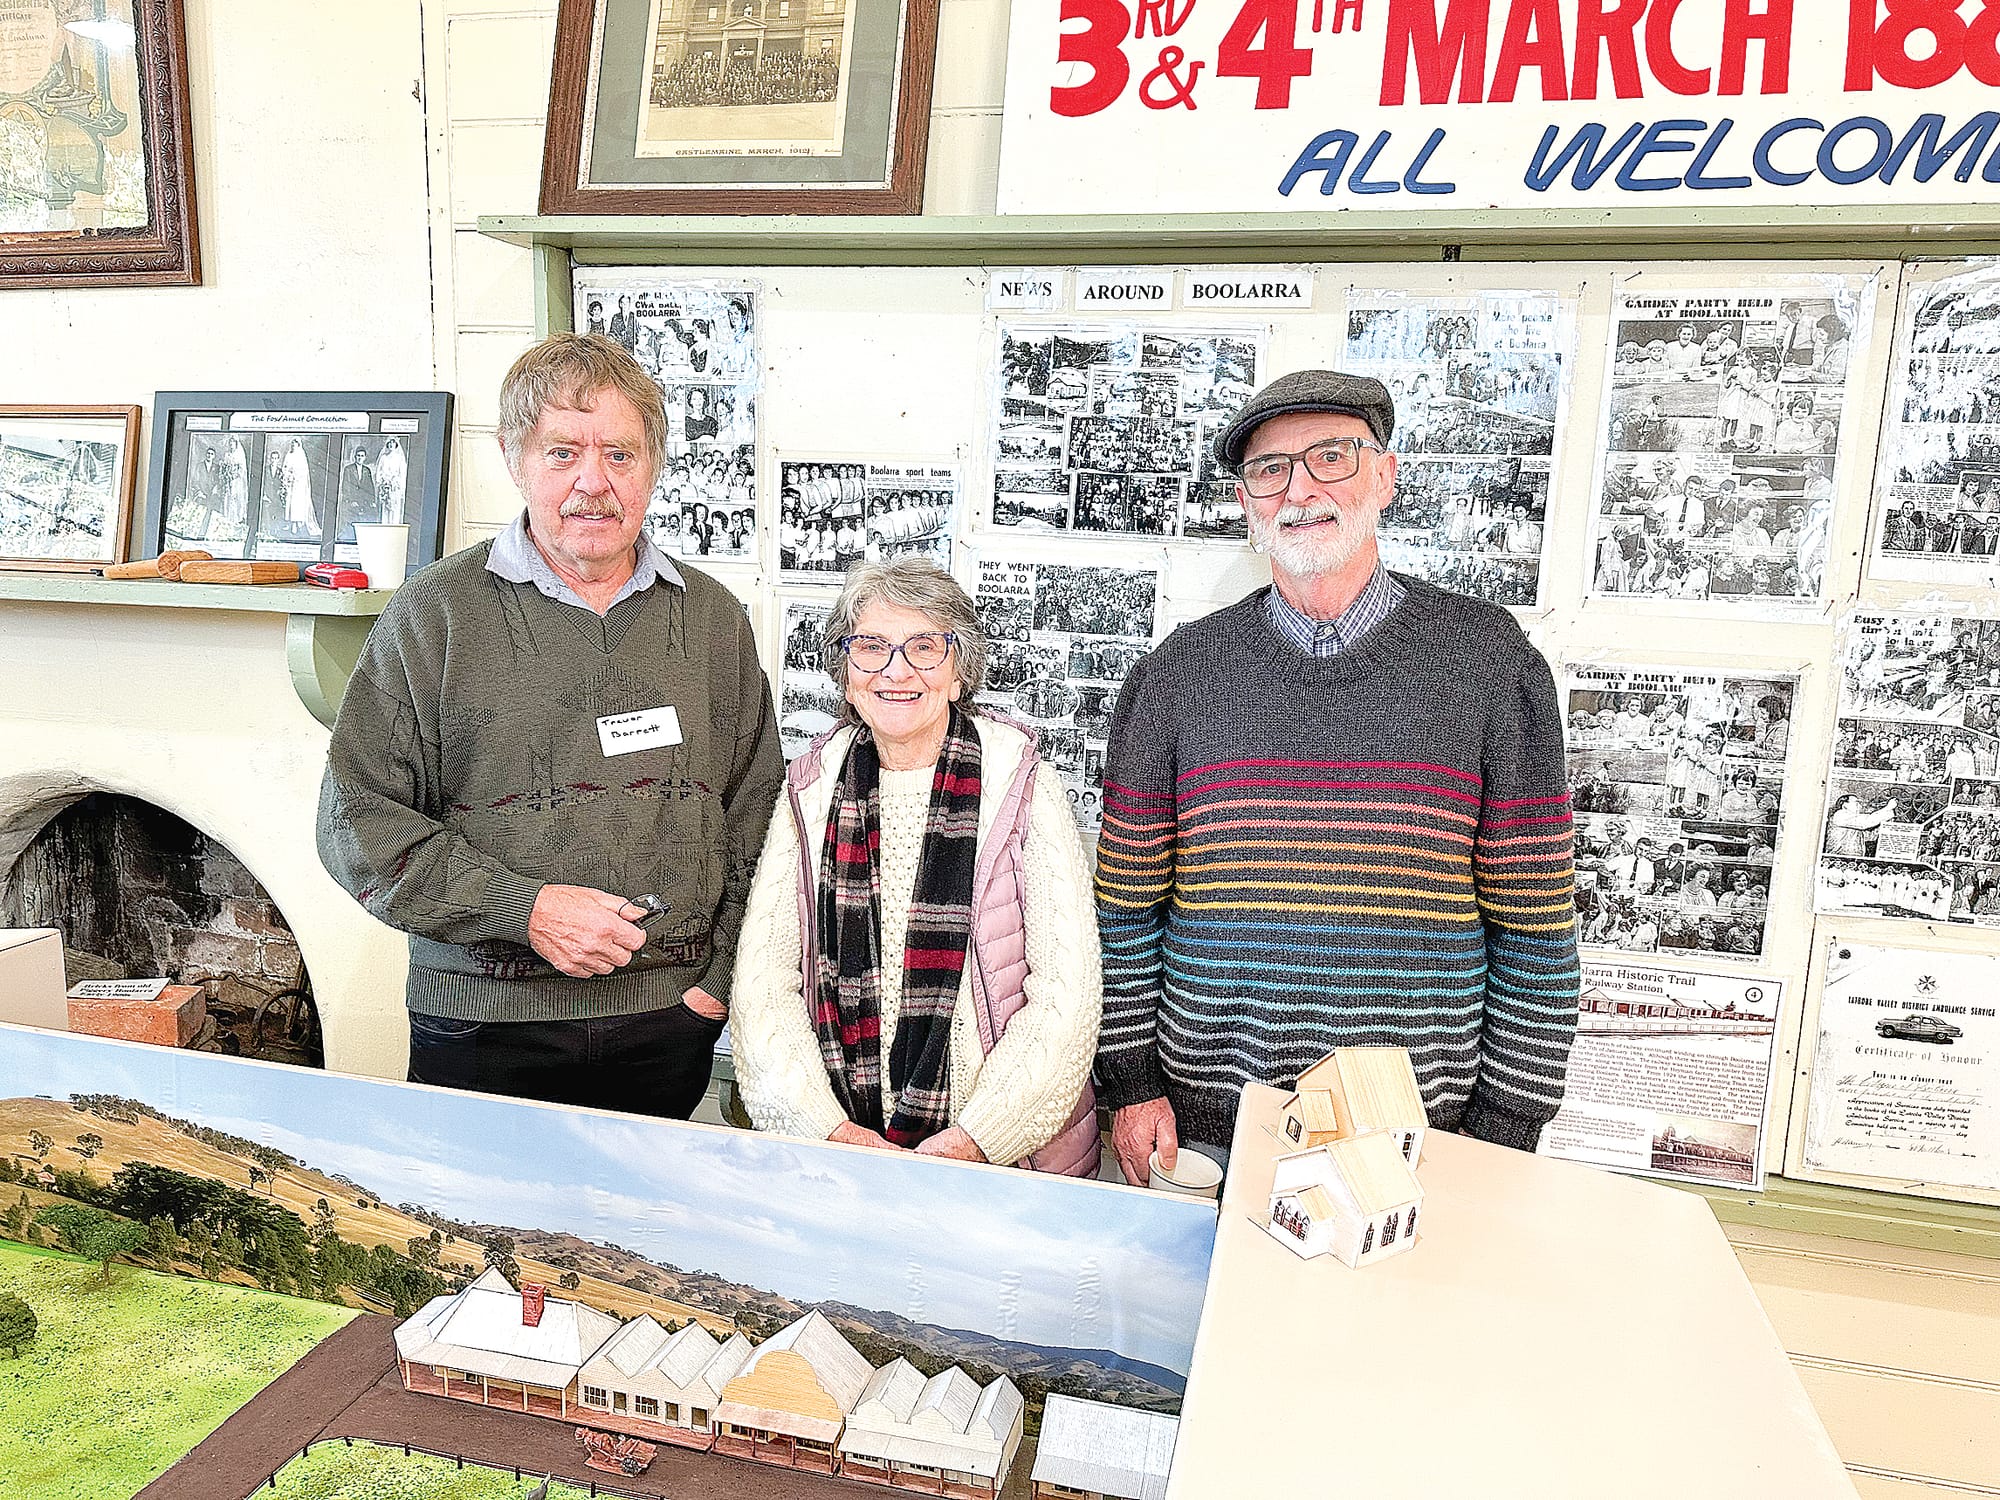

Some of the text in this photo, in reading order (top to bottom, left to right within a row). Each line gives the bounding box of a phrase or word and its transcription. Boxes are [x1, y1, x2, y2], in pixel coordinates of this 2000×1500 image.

[1139, 45, 1206, 111] &
[1379, 0, 1793, 106] MARCH
[1278, 111, 2000, 196] ALL WELCOM
[1000, 282, 1301, 300] NEWS AROUND BOOLARRA
[1625, 299, 1773, 308] GARDEN PARTY HELD
[1655, 309, 1750, 318] AT BOOLARRA
[870, 465, 951, 477] Boolarra sport teams
[979, 561, 1035, 572] THEY WENT
[983, 573, 1027, 583] BACK TO
[978, 584, 1030, 595] BOOLARRA
[1854, 615, 1885, 625] Busy
[1576, 671, 1626, 680] GARDEN
[1633, 673, 1676, 683] PARTY
[1605, 682, 1622, 690] AT
[601, 716, 643, 726] Trevor
[611, 724, 660, 738] Barrett
[1617, 970, 1664, 982] Historic
[1667, 974, 1696, 986] Trail
[1585, 979, 1663, 993] Railway Station
[1848, 996, 1996, 1017] LATROBE VALLEY DISTRICT AMBULANCE SERVICE
[1855, 1045, 1982, 1065] Certificate of Honour
